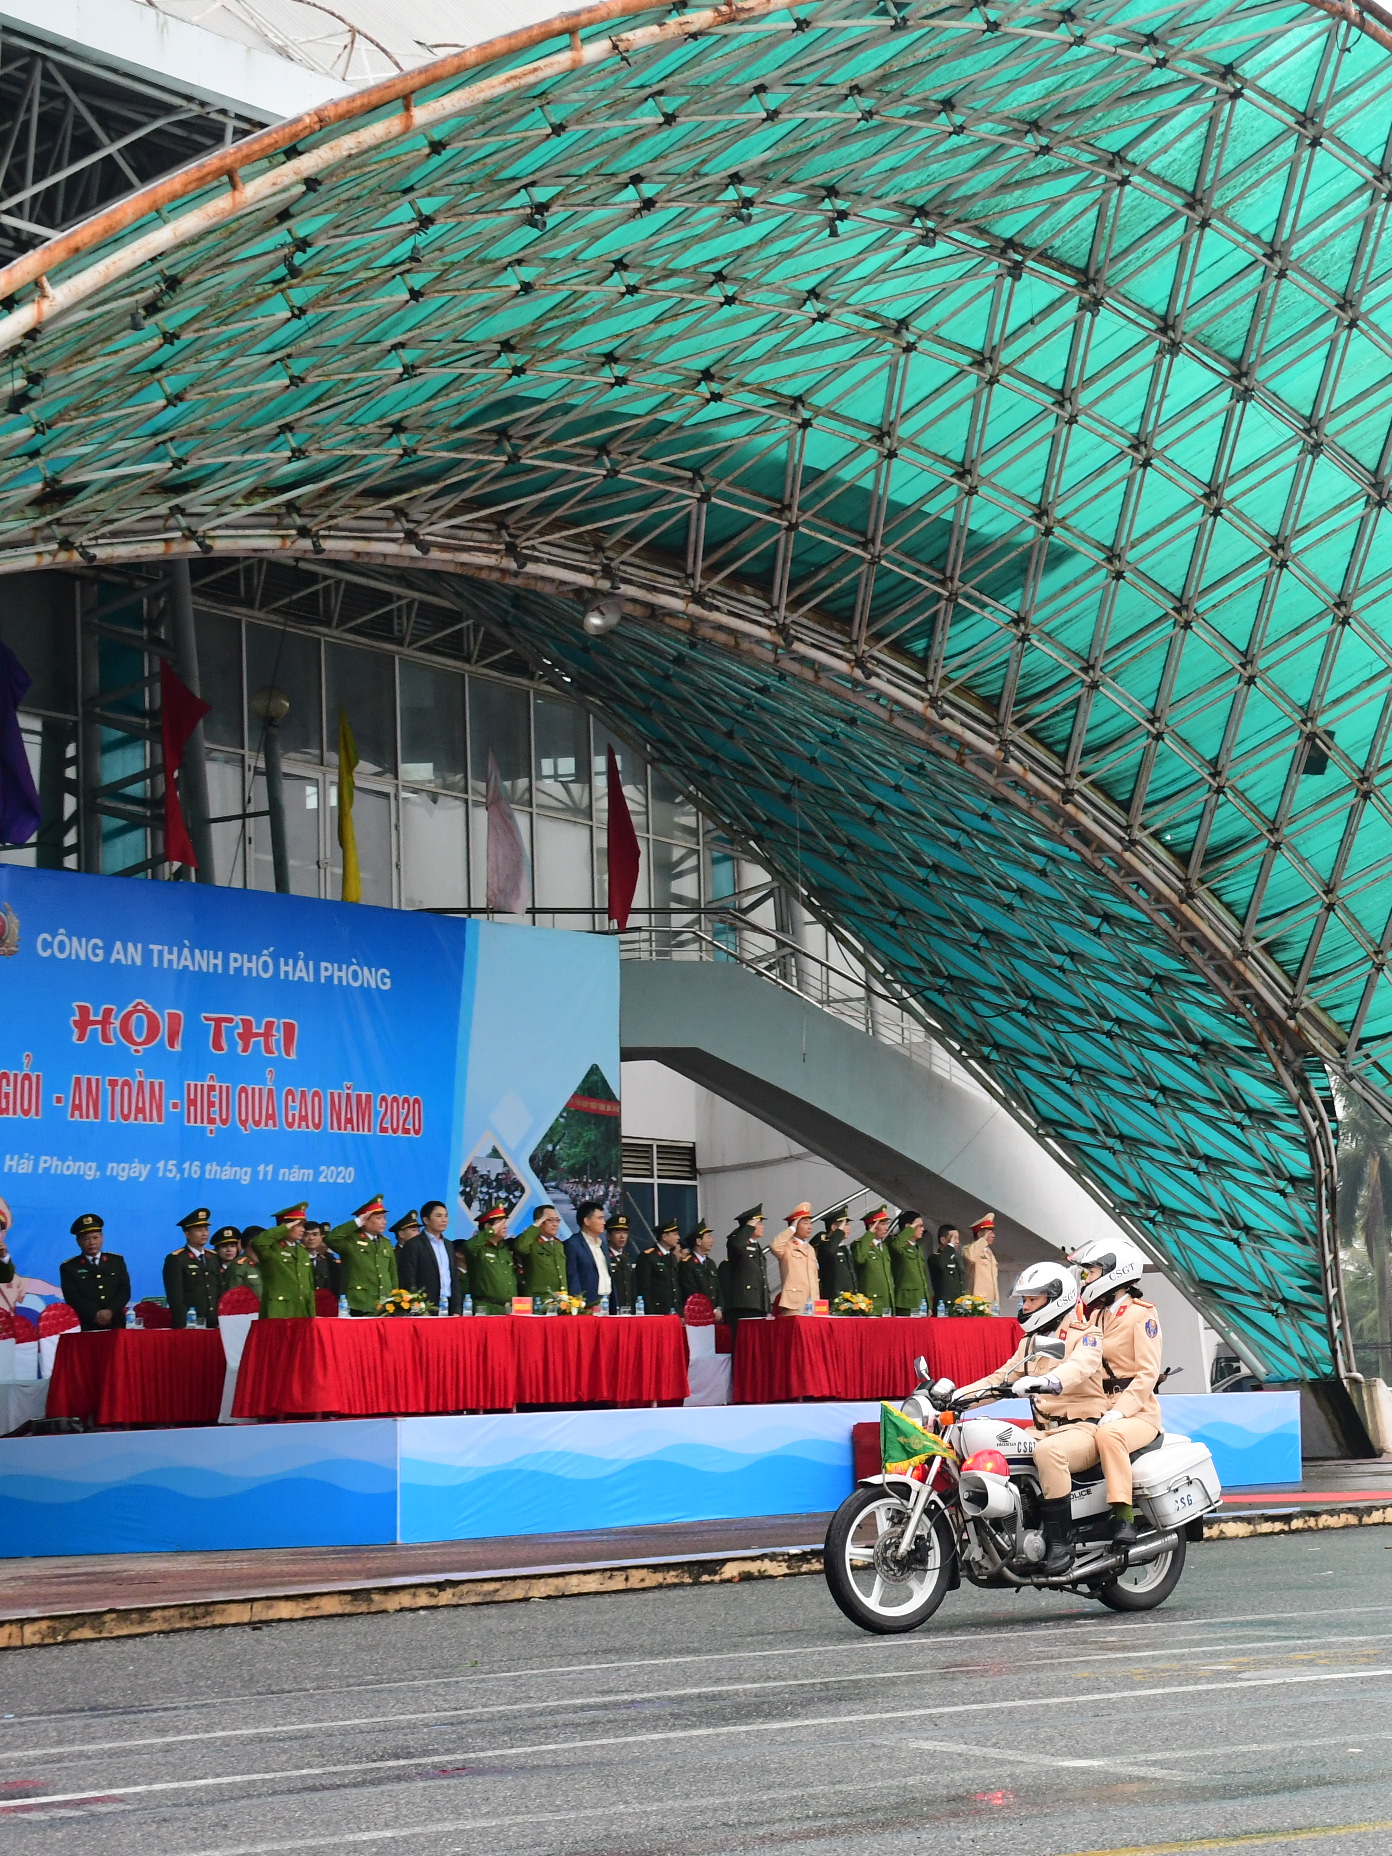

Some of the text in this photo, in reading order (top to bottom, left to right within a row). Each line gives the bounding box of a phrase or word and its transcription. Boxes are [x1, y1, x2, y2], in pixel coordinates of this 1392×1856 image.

[36, 928, 392, 990] CÔNG AN THÀNH PHỐ HẢI PHÒNG
[71, 998, 298, 1060] HỘI THI
[0, 1052, 42, 1118] GIỎI
[68, 1074, 101, 1122] AN
[106, 1068, 165, 1124] TOÀN
[184, 1073, 232, 1137] HIỆU
[236, 1067, 279, 1135] QUẢ
[282, 1086, 324, 1133] CAO
[328, 1081, 374, 1135] NĂM
[377, 1093, 424, 1138] 2020
[4, 1152, 355, 1185] Hải Phòng, ngày 15,16 tháng 11 năm 2020
[1108, 1262, 1135, 1282] CSGT
[1056, 1289, 1077, 1308] CSGT
